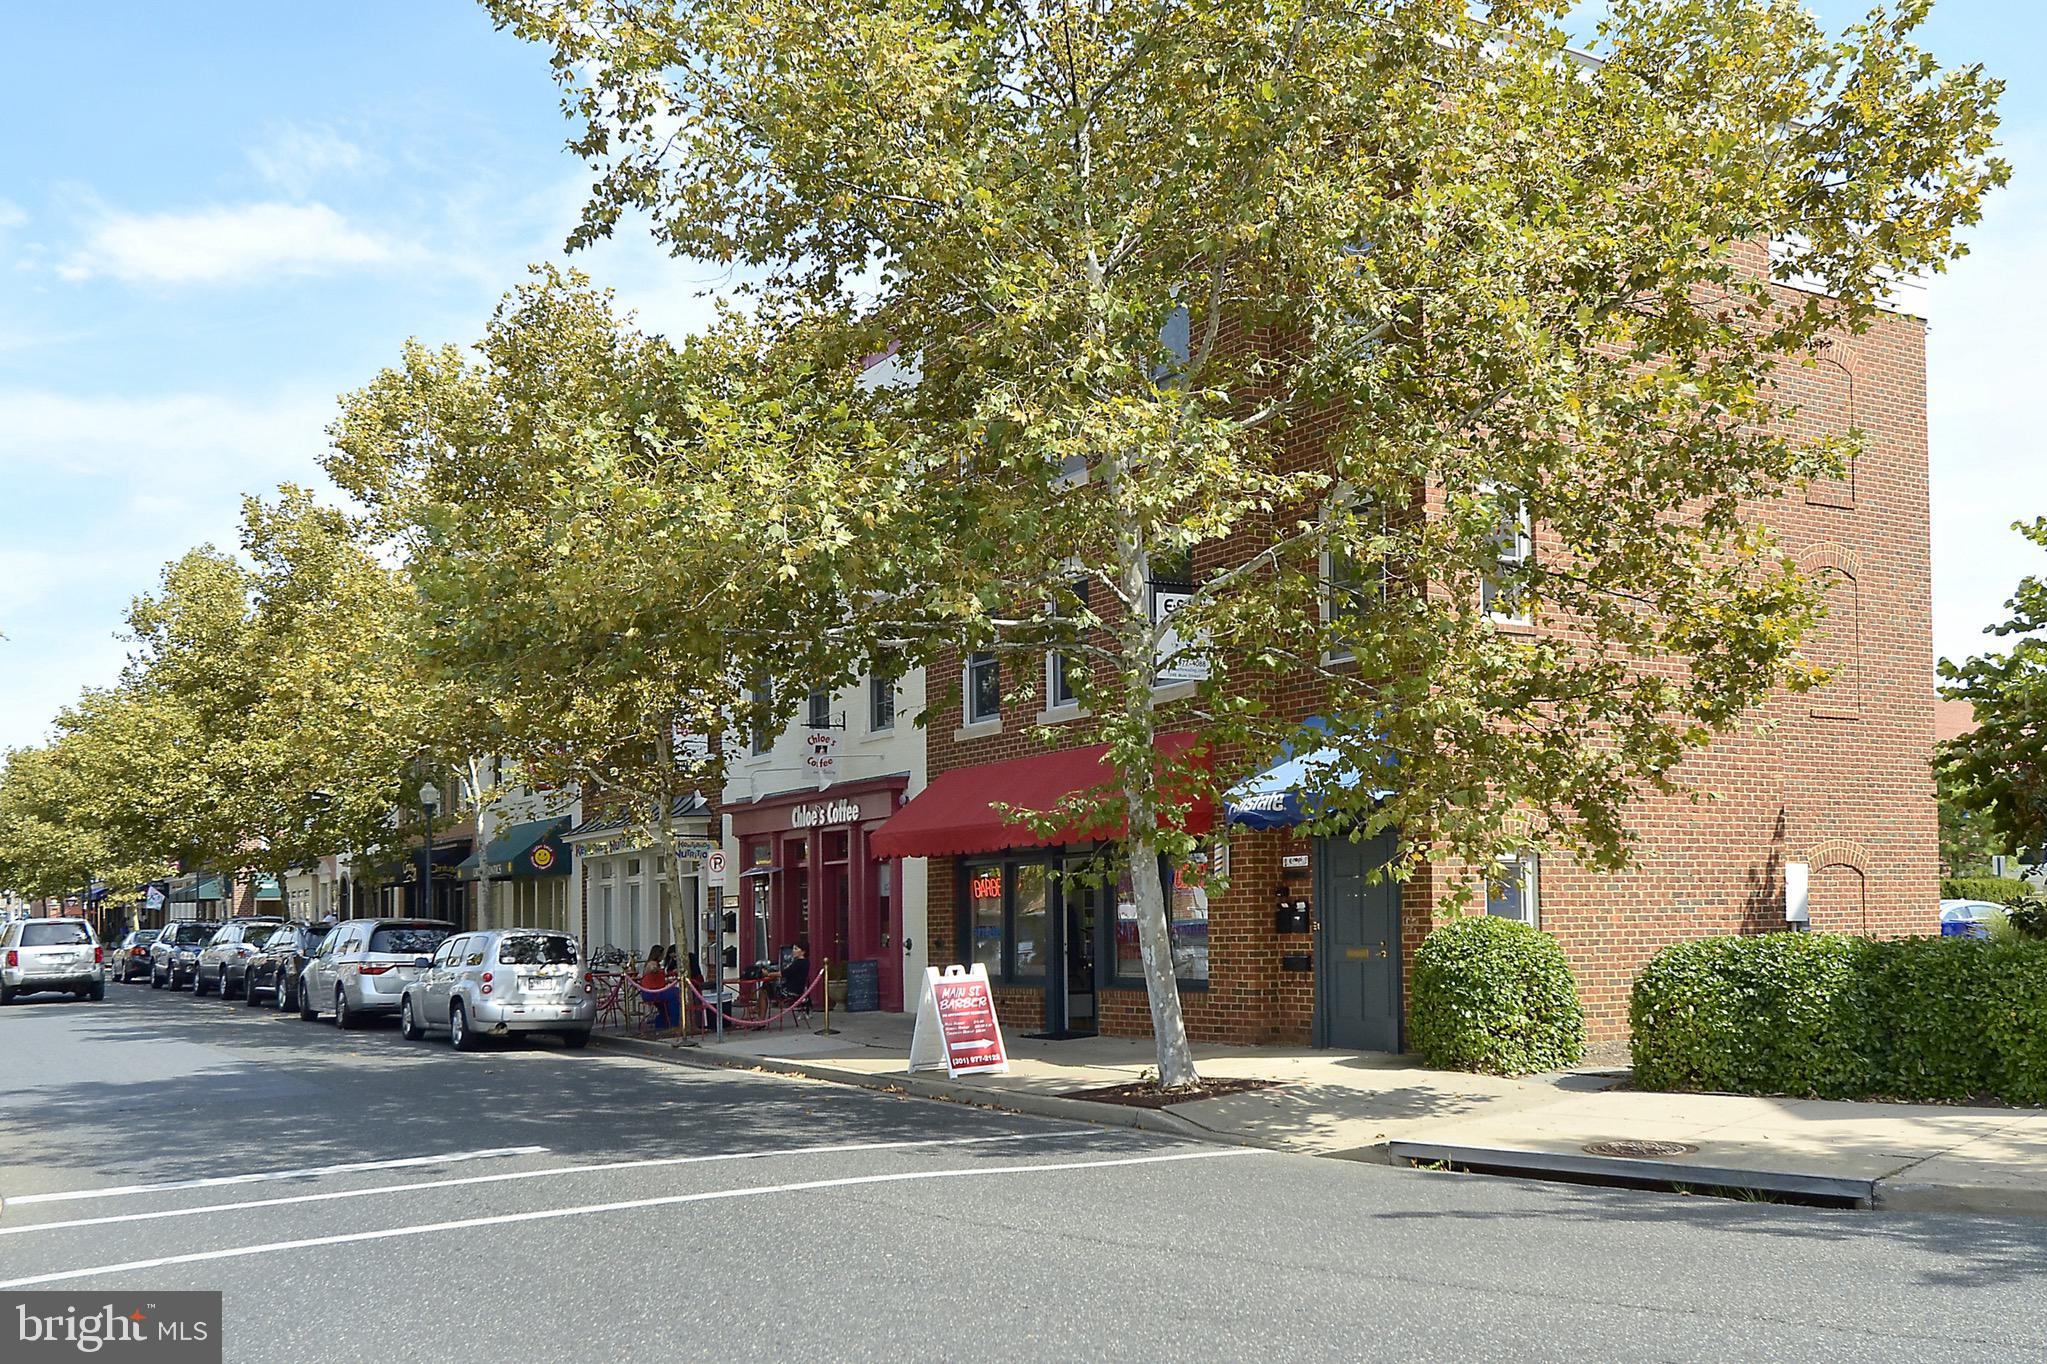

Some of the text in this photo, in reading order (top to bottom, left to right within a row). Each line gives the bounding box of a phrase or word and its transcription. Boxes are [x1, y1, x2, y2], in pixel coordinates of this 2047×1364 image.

[807, 757, 833, 768] Cofee
[792, 798, 860, 829] Chloe's Coffee
[973, 878, 1002, 899] BARBE
[942, 987, 966, 999] MAIN
[940, 996, 988, 1011] BARBER
